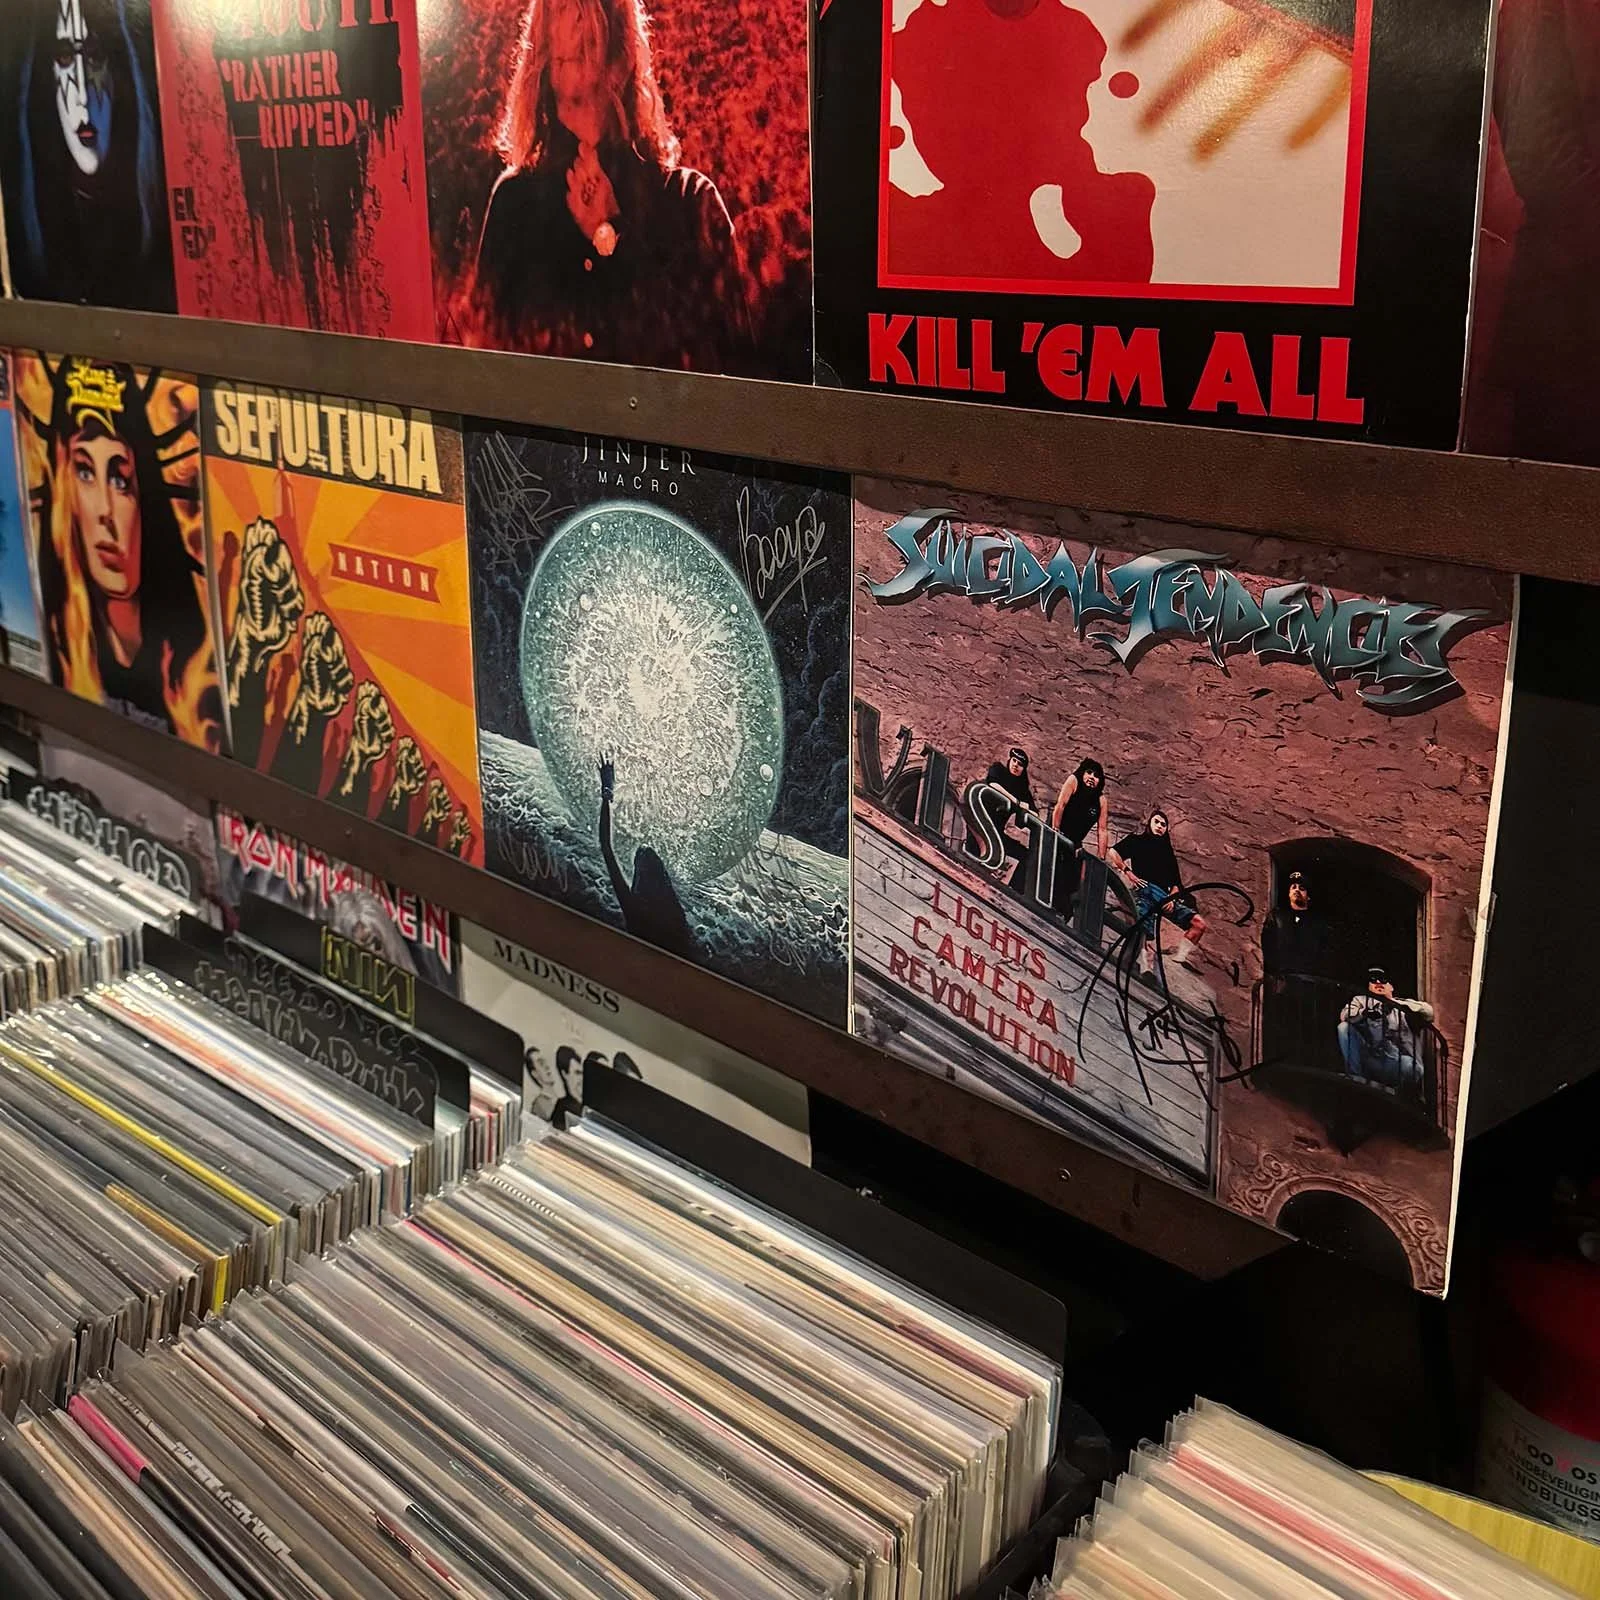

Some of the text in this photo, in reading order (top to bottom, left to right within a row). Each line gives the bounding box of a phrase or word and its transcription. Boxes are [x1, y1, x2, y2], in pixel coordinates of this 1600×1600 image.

[220, 49, 342, 102] "RATHER
[259, 99, 369, 149] RIPPED"
[867, 312, 1365, 426] KILL 'EM ALL
[213, 380, 443, 495] SEPULTURA
[581, 436, 697, 476] JINJER
[598, 470, 679, 496] MACRO
[338, 551, 430, 593] NATION
[856, 507, 1130, 634] SUICIDAL
[217, 803, 299, 898] IRON
[493, 938, 621, 1014] MADNESS
[913, 915, 1060, 1035] CAMERA
[931, 881, 1048, 982] LIGHTS
[888, 942, 1077, 1089] REVOLUTION
